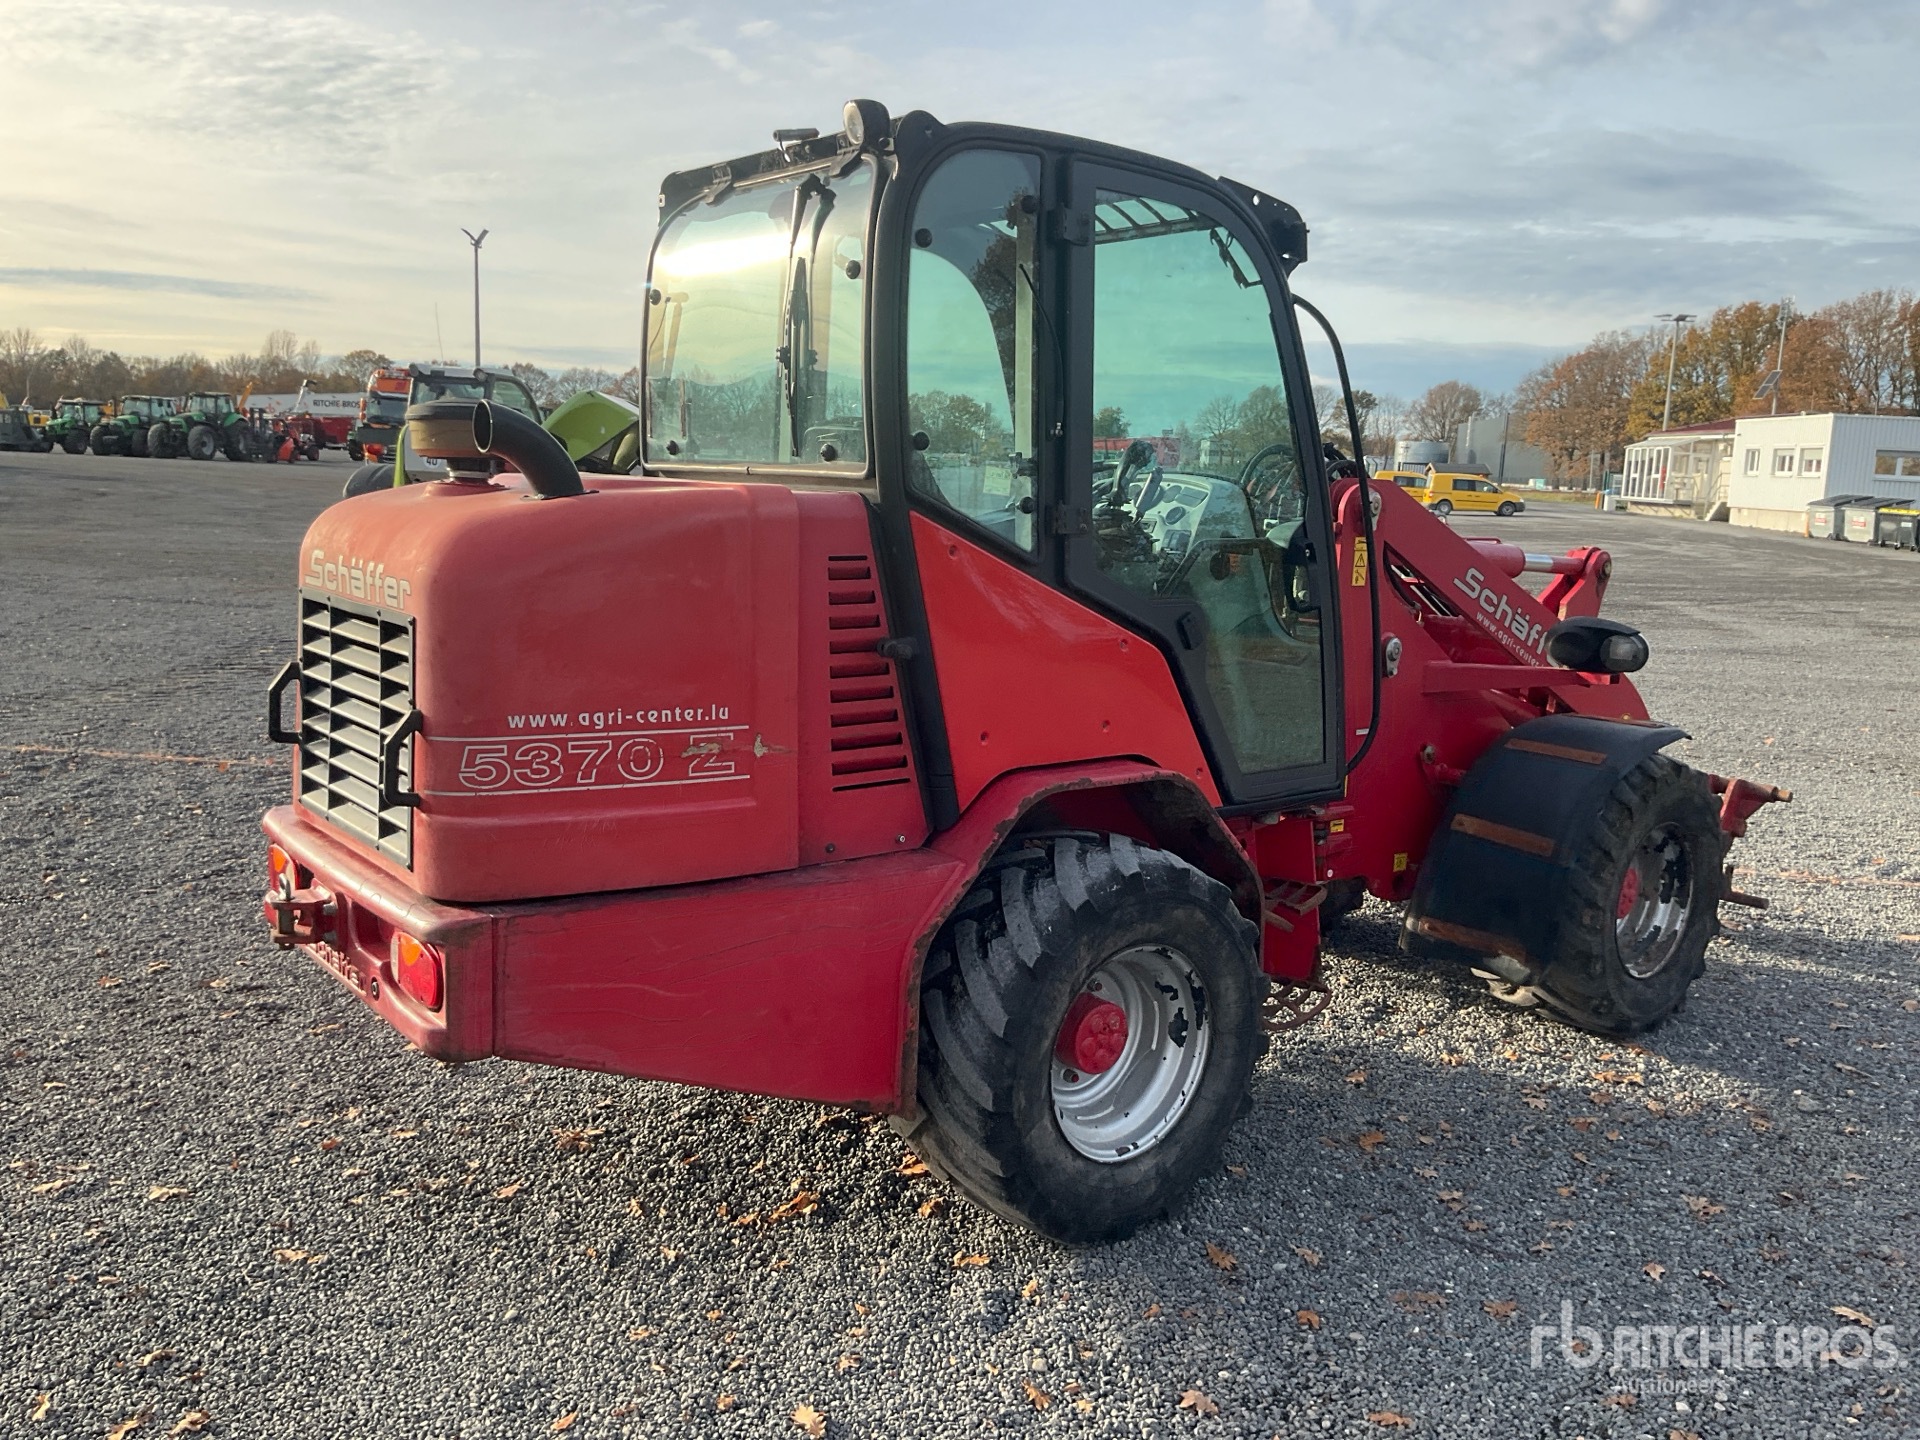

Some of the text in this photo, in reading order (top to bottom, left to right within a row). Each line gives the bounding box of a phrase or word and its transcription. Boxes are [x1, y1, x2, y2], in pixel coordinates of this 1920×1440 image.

[304, 549, 411, 610] Schäffer
[1453, 567, 1571, 669] Schäff
[1476, 612, 1545, 668] www.agri-center
[458, 732, 735, 789] 5370 Z
